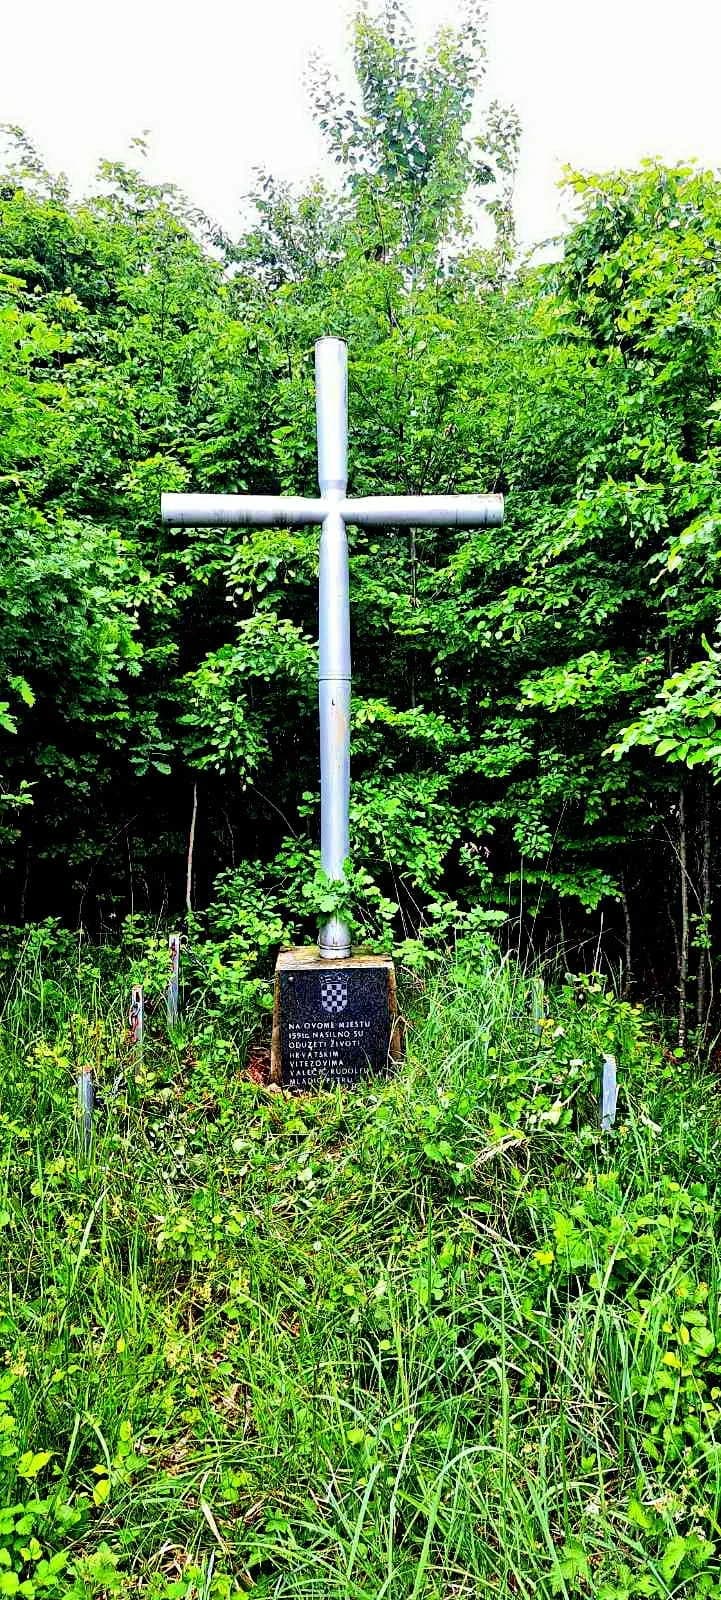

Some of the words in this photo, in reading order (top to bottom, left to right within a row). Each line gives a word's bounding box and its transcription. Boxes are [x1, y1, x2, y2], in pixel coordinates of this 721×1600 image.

[303, 1021, 335, 1030] OVOME
[338, 1020, 371, 1029] MJESTU
[312, 1030, 350, 1039] NASILNO
[288, 1041, 327, 1049] ODUZETI
[330, 1039, 360, 1048] ŽIVOTI
[289, 1051, 339, 1059] HRVATSKIM
[289, 1059, 344, 1068] VITEZOVIMA
